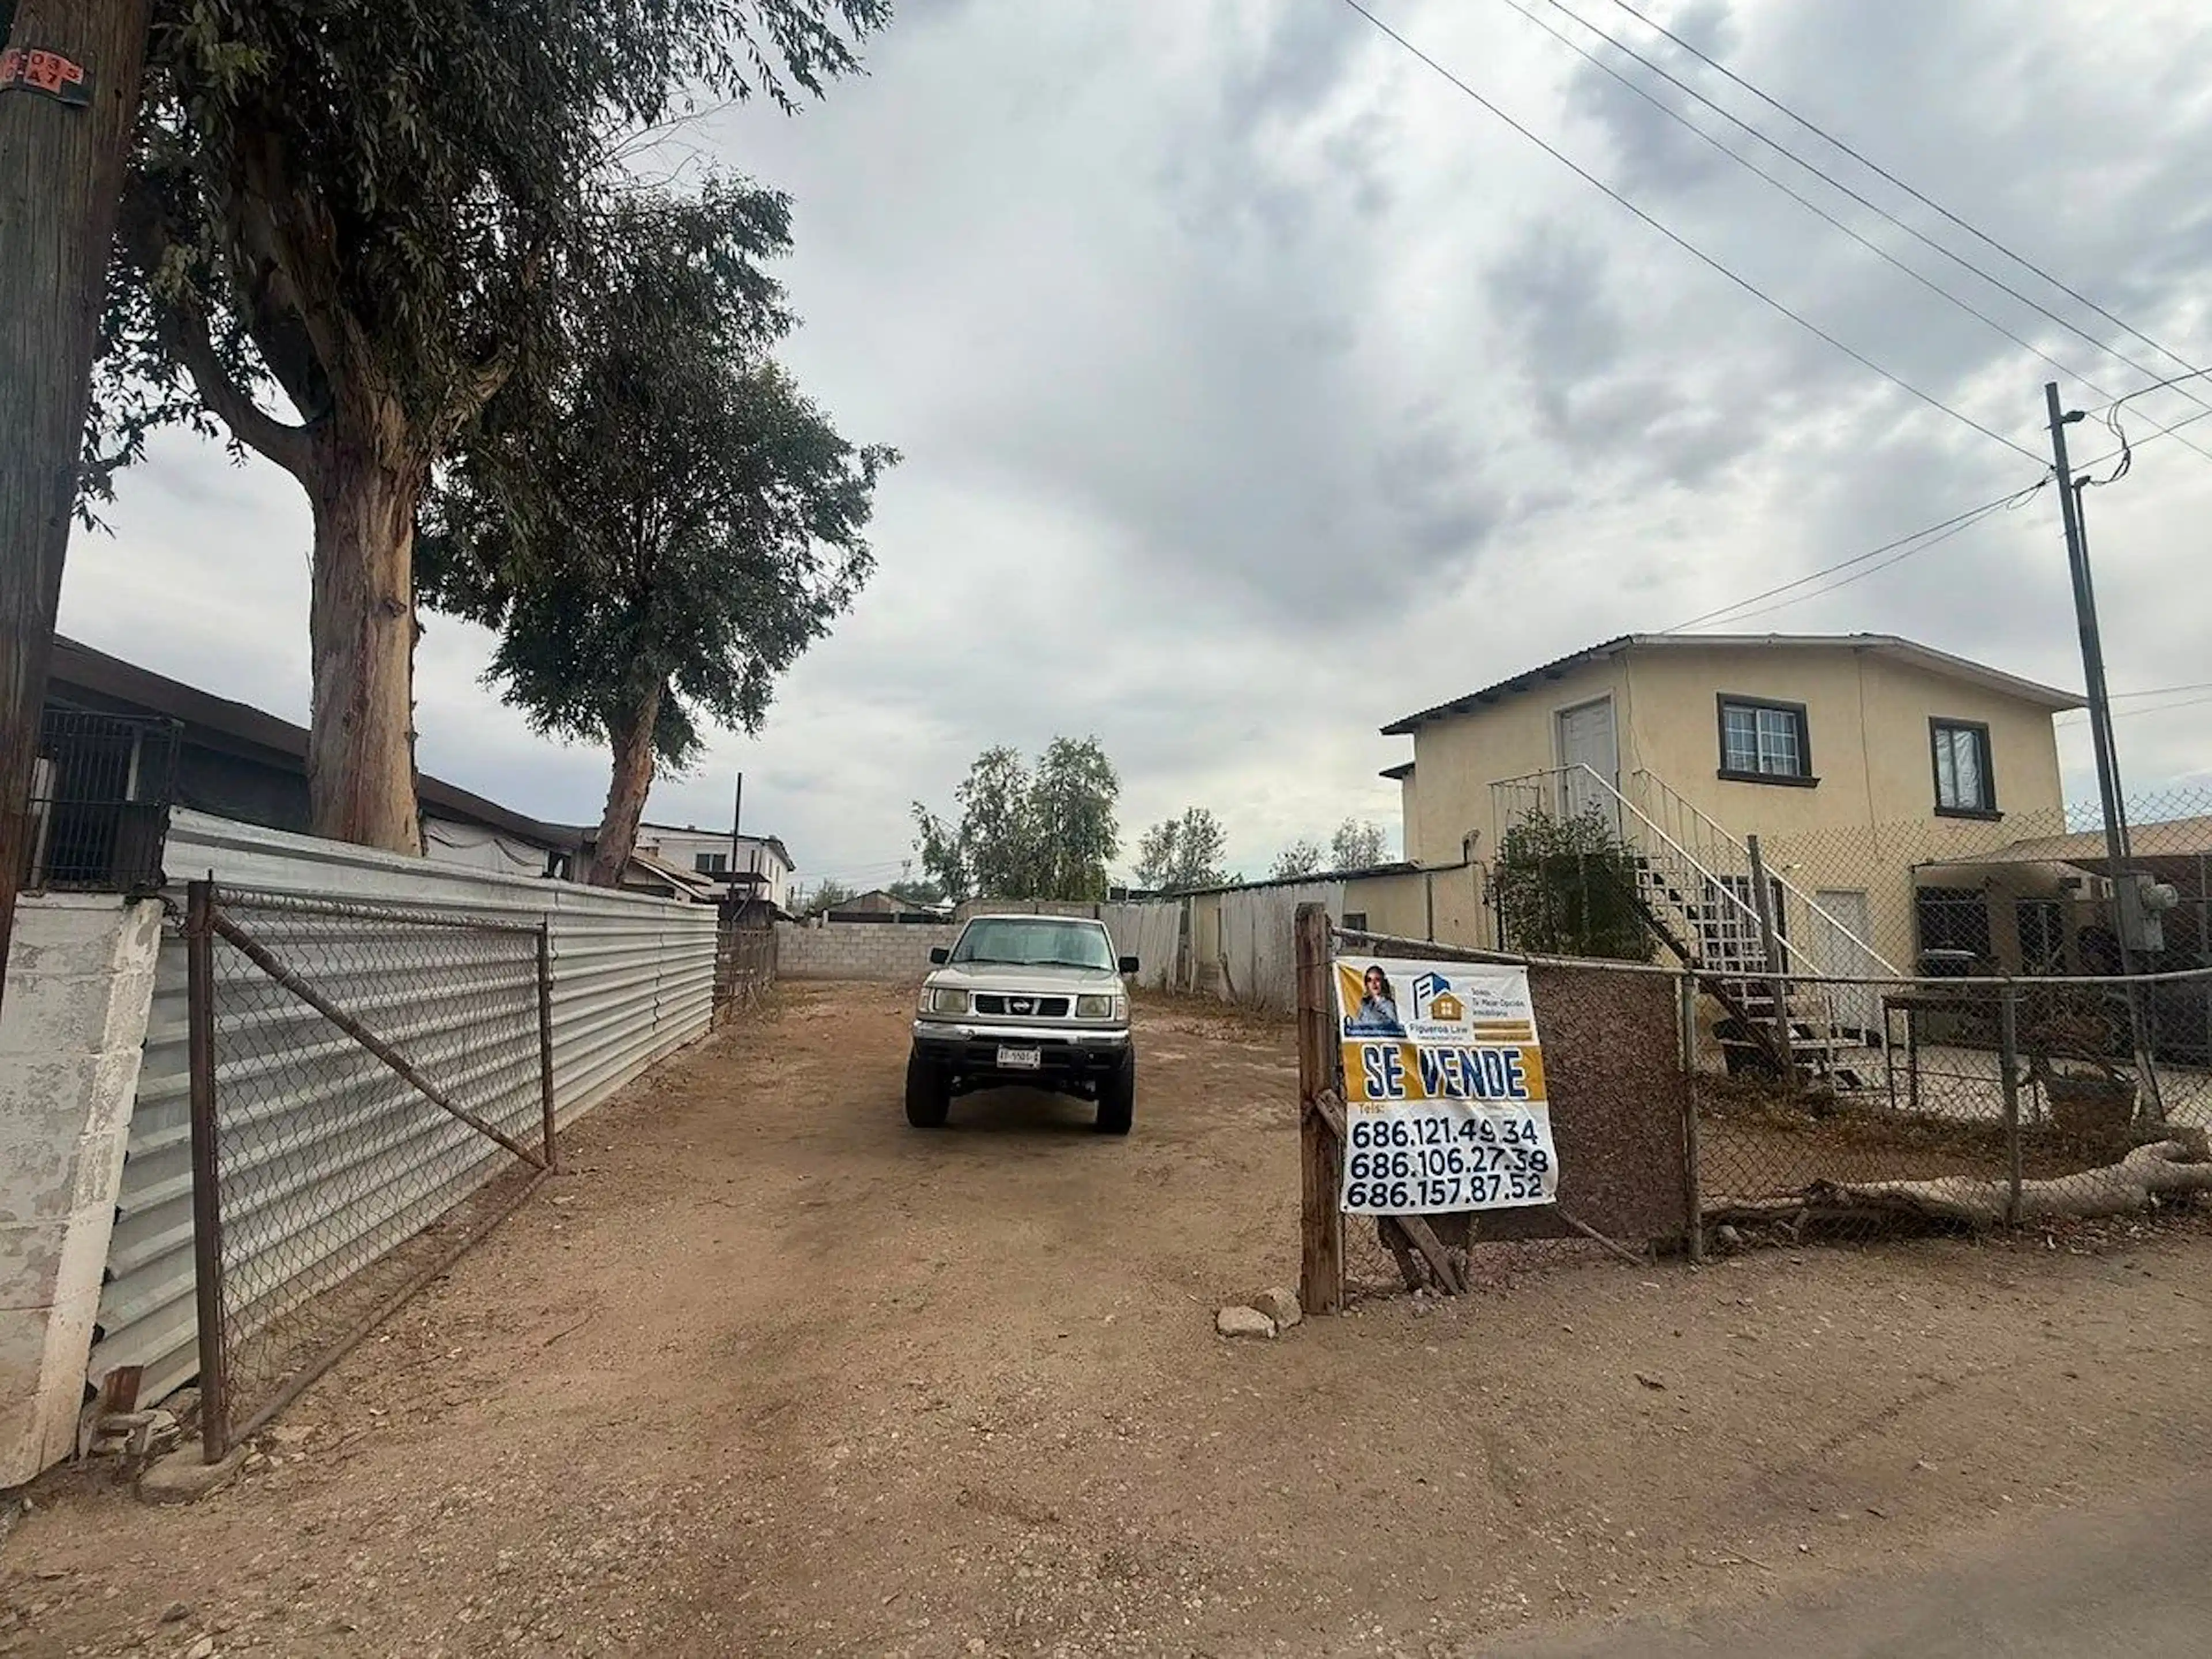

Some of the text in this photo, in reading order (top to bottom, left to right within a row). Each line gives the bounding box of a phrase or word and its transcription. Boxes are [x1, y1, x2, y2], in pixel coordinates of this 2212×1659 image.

[1362, 1045, 1528, 1099] SE VENDE
[1351, 1146, 1549, 1179] 686.106.27.38
[1347, 1173, 1543, 1207] 686.157.87.52
